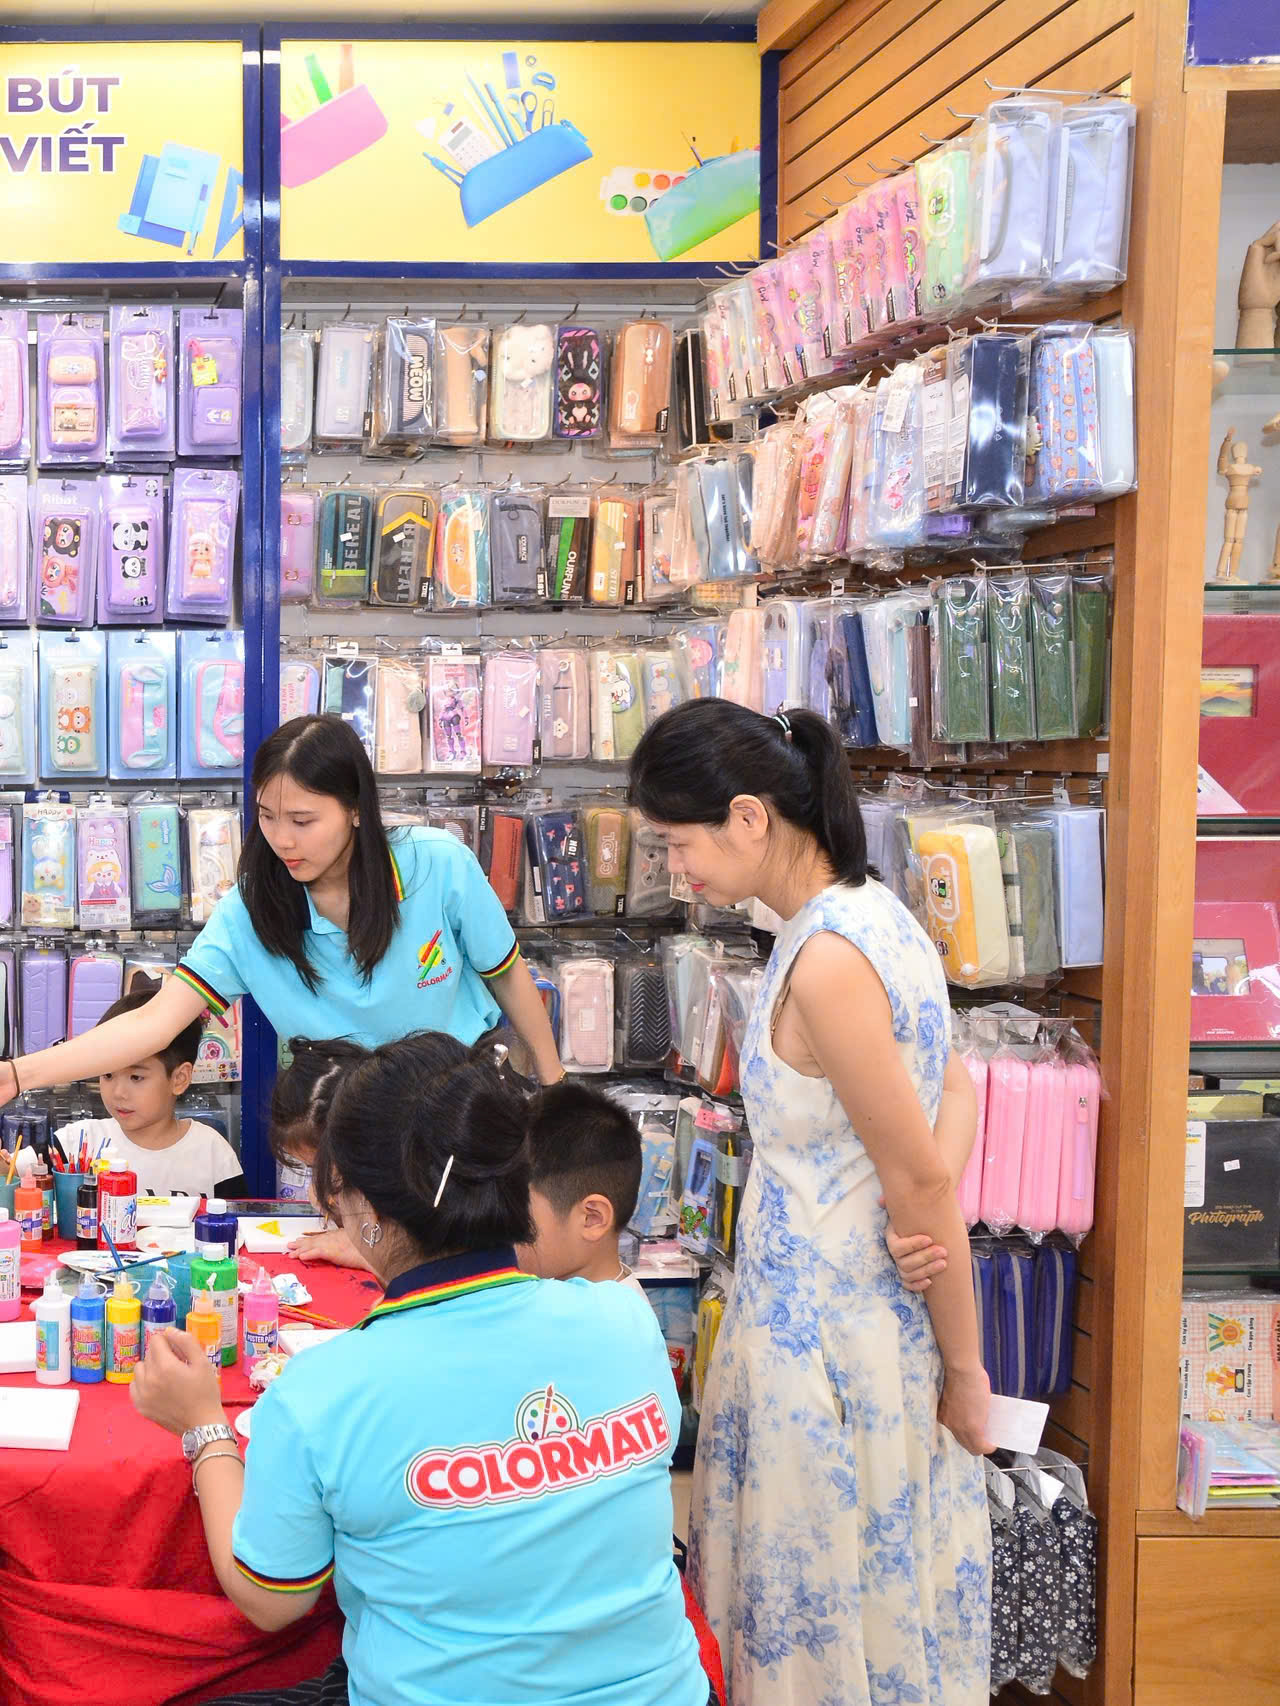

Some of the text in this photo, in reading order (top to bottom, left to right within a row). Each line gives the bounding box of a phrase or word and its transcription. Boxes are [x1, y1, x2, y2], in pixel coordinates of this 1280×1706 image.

[7, 66, 120, 113] BÚT
[407, 353, 425, 403] MEOW
[344, 495, 362, 572] BEREAL
[397, 522, 414, 602] BEREAL
[561, 551, 577, 596] OURFUN
[88, 836, 118, 851] Happy
[1188, 1209, 1266, 1228] Photograph
[246, 1334, 264, 1344] POSTER
[416, 1401, 670, 1500] COLORMATE
